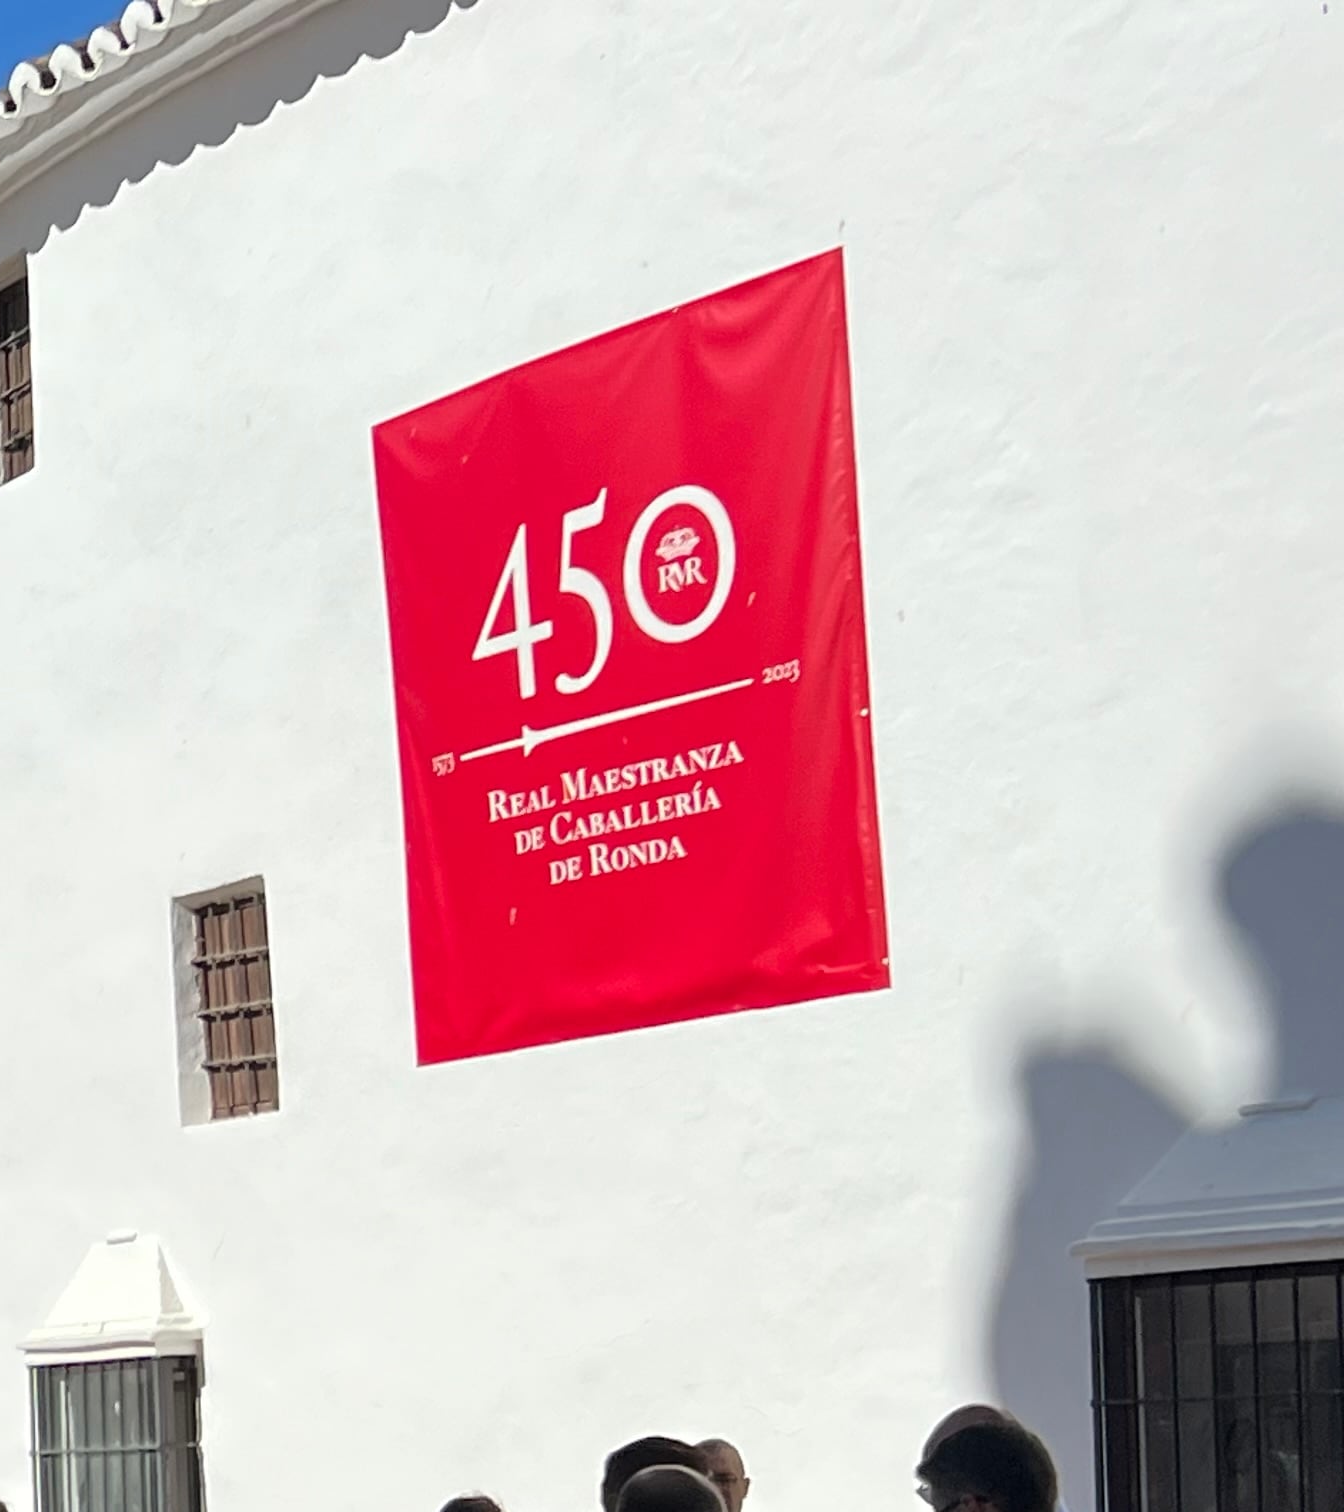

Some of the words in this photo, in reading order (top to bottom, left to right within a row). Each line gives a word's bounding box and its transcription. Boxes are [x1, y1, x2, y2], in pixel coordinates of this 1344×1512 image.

[472, 484, 736, 699] 450
[762, 658, 801, 684] 2023
[487, 785, 556, 823] REAL
[560, 740, 744, 804] MAESTRANZA
[514, 826, 546, 855] DE
[550, 780, 722, 845] CABALLERÍA
[549, 856, 583, 885] DE
[588, 835, 688, 877] RONDA
